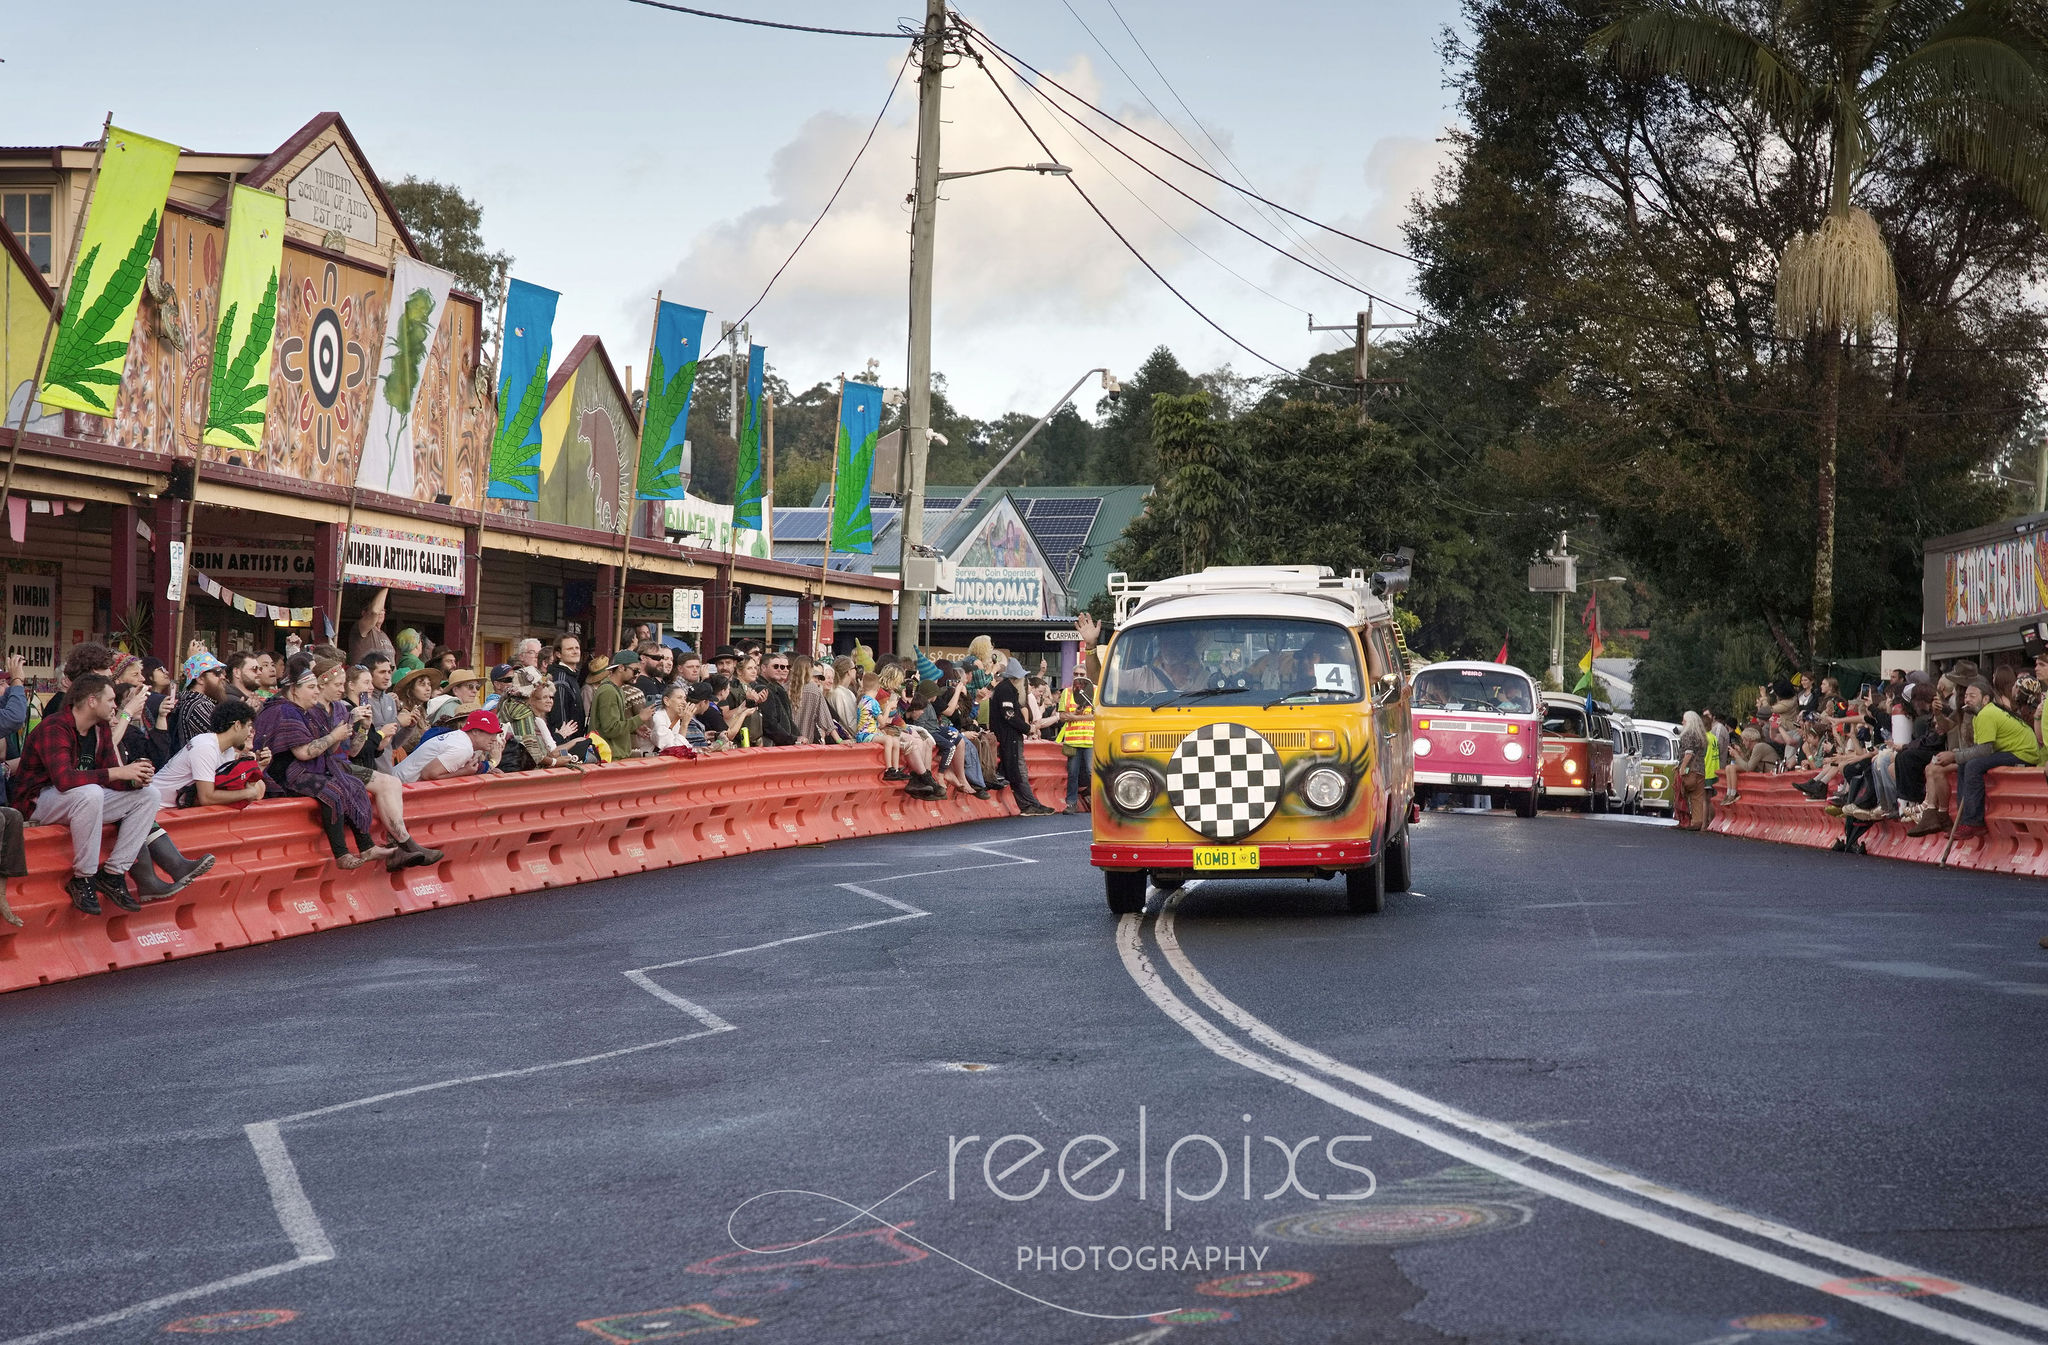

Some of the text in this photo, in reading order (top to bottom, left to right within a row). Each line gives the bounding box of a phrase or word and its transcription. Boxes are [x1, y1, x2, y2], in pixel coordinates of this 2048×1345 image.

[298, 181, 368, 220] SCHOOL OF ARTS
[312, 205, 353, 233] EST 1904
[227, 553, 289, 573] ARTISTS
[346, 541, 458, 578] NIMBIN ARTISTS GALLERY
[984, 568, 1001, 577] Coin
[1002, 568, 1036, 578] Operated
[1956, 540, 2037, 624] EMPORIUM
[12, 584, 50, 608] NIMBIN
[939, 581, 1037, 602] UNDROMAT
[966, 606, 1035, 617] Down Under
[12, 614, 50, 638] ARTISTS
[1052, 632, 1081, 640] CARPARK
[1325, 666, 1345, 687] 4
[1196, 852, 1257, 866] KOMBI 8
